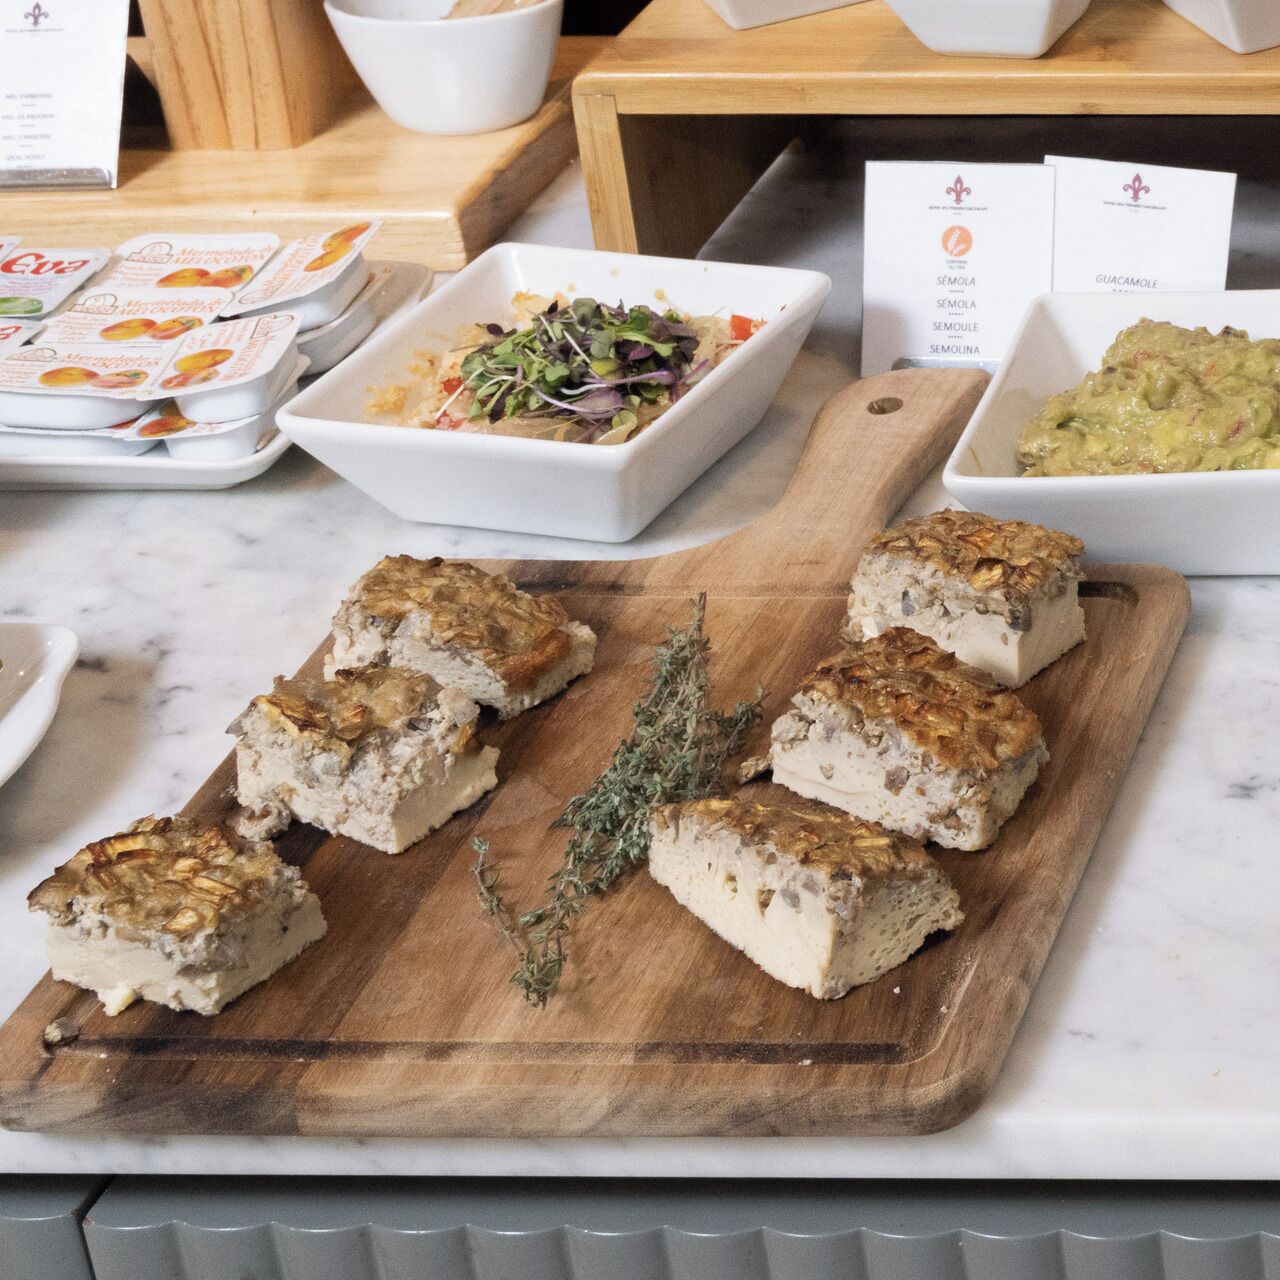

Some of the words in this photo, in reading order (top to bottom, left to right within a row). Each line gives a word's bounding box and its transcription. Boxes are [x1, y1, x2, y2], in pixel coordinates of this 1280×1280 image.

[1095, 273, 1158, 289] GUACAMOLE
[932, 321, 978, 332] SEMOULE
[930, 344, 980, 355] SEMOLINA
